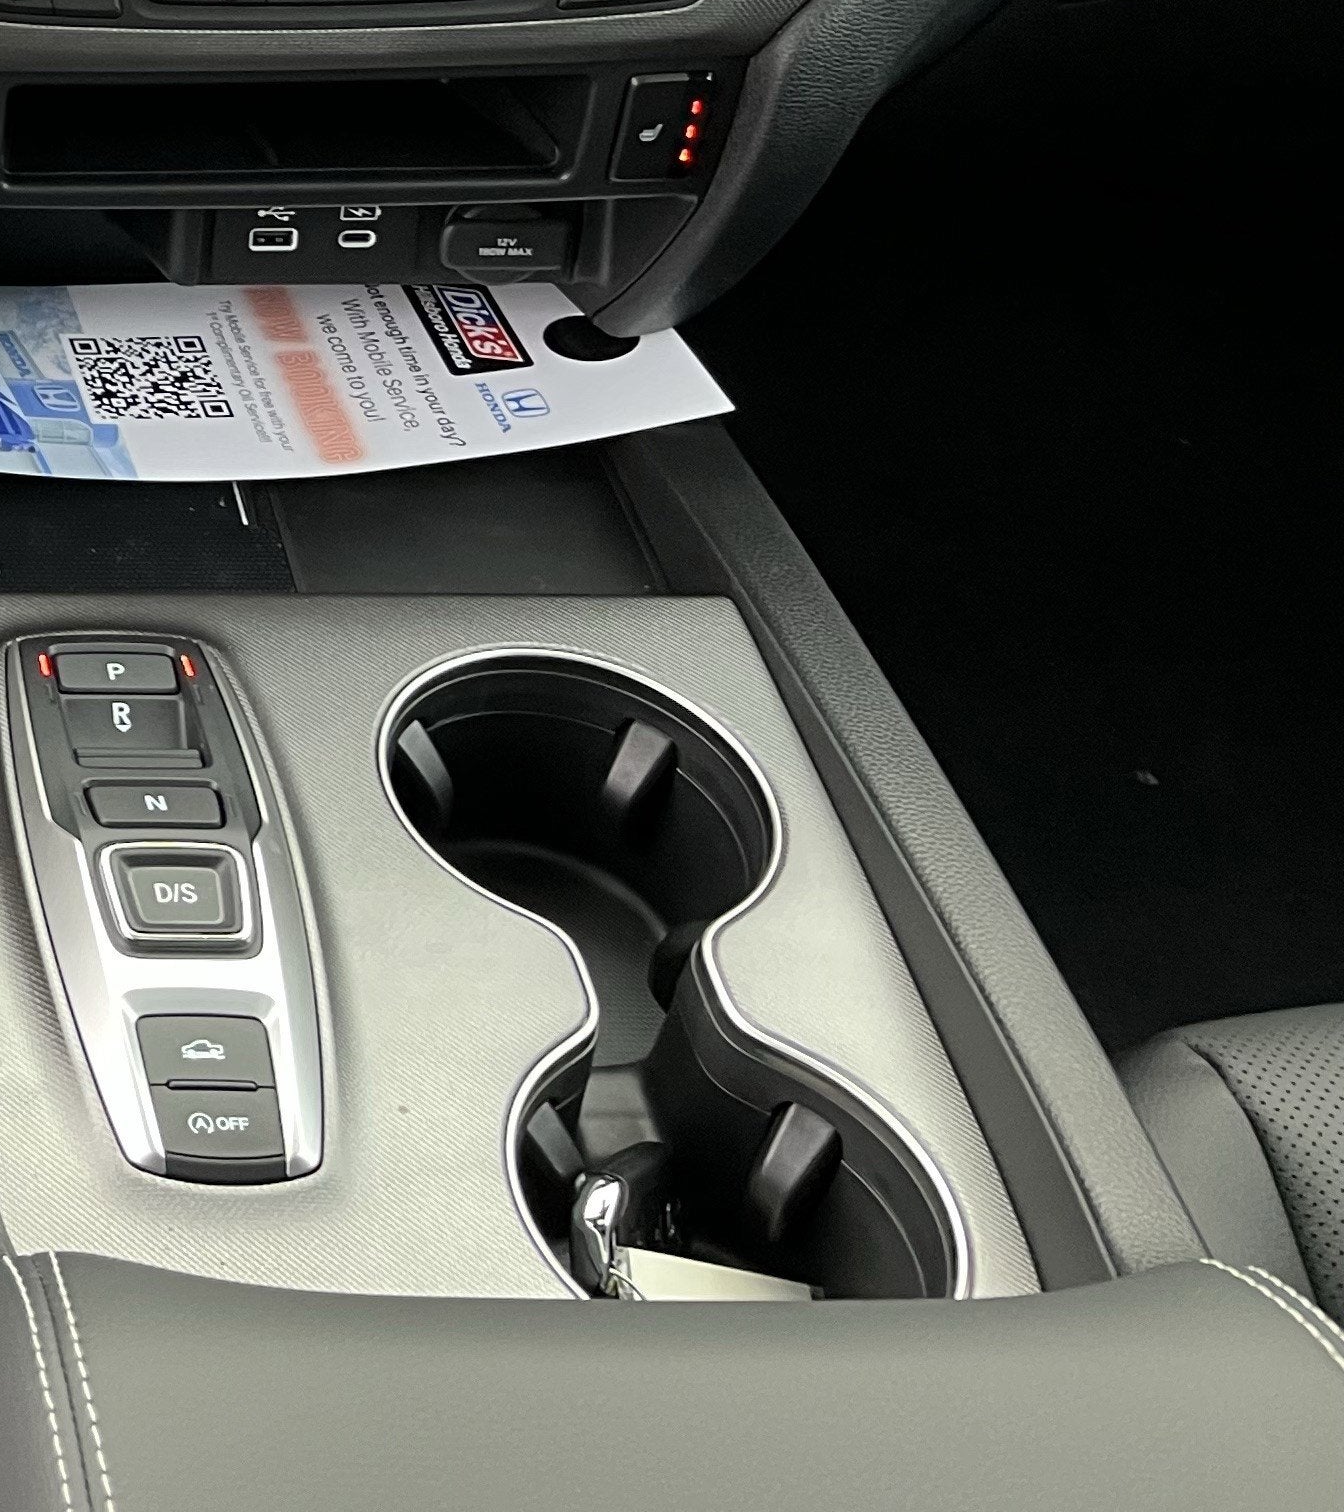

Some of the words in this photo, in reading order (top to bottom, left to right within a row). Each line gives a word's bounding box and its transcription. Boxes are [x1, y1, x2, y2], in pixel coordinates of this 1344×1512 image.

[219, 300, 232, 313] Try
[225, 314, 245, 343] Mobile
[316, 313, 337, 334] we
[374, 300, 410, 345] enough
[209, 323, 246, 387] Complimentary
[239, 389, 254, 402] Oil
[239, 345, 260, 376] Service
[327, 336, 357, 373] come
[398, 346, 422, 373] time
[439, 332, 472, 369] Honda
[341, 298, 368, 329] With
[358, 331, 393, 376] Mobile
[383, 378, 419, 432] Service,
[254, 377, 266, 390] for
[346, 376, 365, 390] to
[412, 373, 429, 386] in
[260, 391, 274, 408] free
[349, 392, 387, 423] you!
[416, 387, 446, 415] your
[475, 382, 512, 434] HONDA
[267, 410, 284, 429] with
[436, 415, 467, 447] day?
[273, 431, 294, 452] your
[107, 662, 125, 680] P
[112, 702, 130, 726] R
[145, 795, 168, 812] N
[154, 882, 198, 904] D/S
[215, 1116, 249, 1131] OFF
